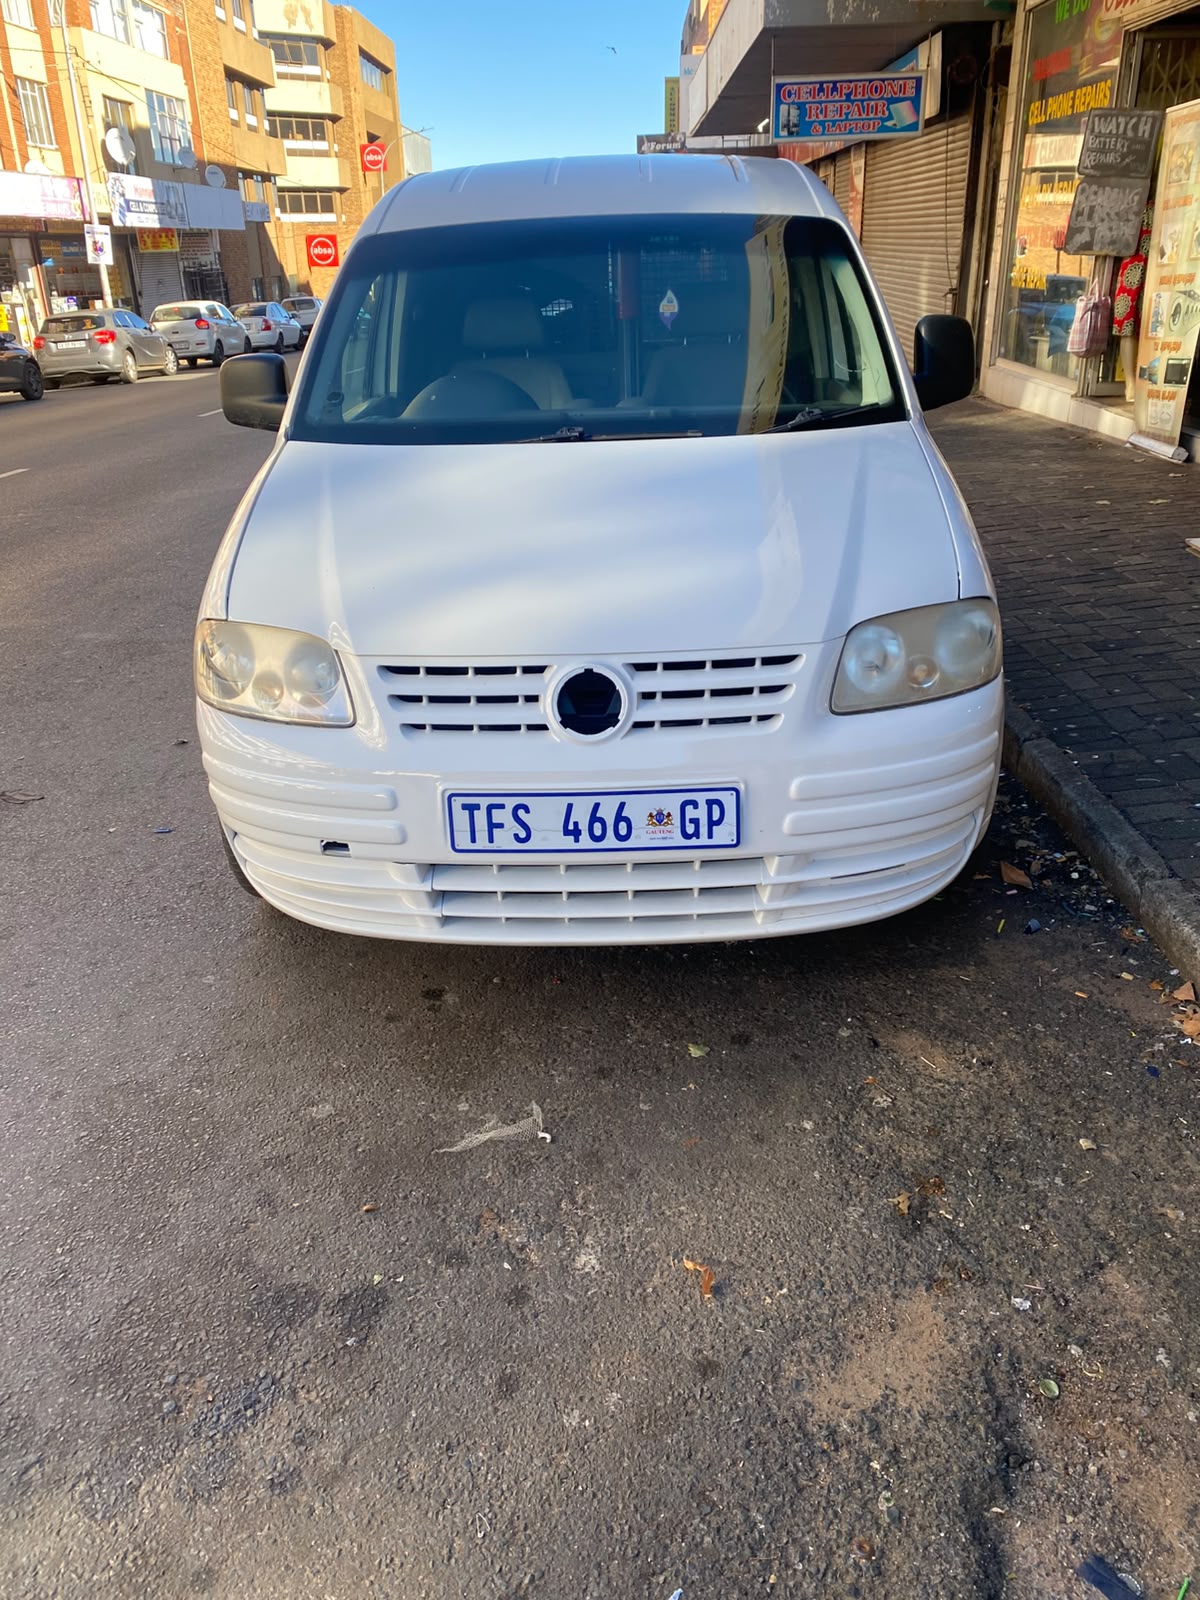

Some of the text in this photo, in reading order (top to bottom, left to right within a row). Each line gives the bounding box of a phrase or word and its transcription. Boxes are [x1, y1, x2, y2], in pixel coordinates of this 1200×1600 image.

[780, 79, 916, 103] CELLPHONE
[806, 101, 889, 121] REPAIR
[1028, 79, 1112, 126] CELL PHONE REPAIRS
[811, 120, 881, 135] & LAPTOP
[1093, 114, 1153, 139] WATCH
[1088, 136, 1130, 152] BATTERY
[366, 151, 382, 161] absa
[1084, 150, 1122, 169] REPAIRS
[313, 245, 333, 255] absa
[461, 799, 725, 844] TFS 466 GP
